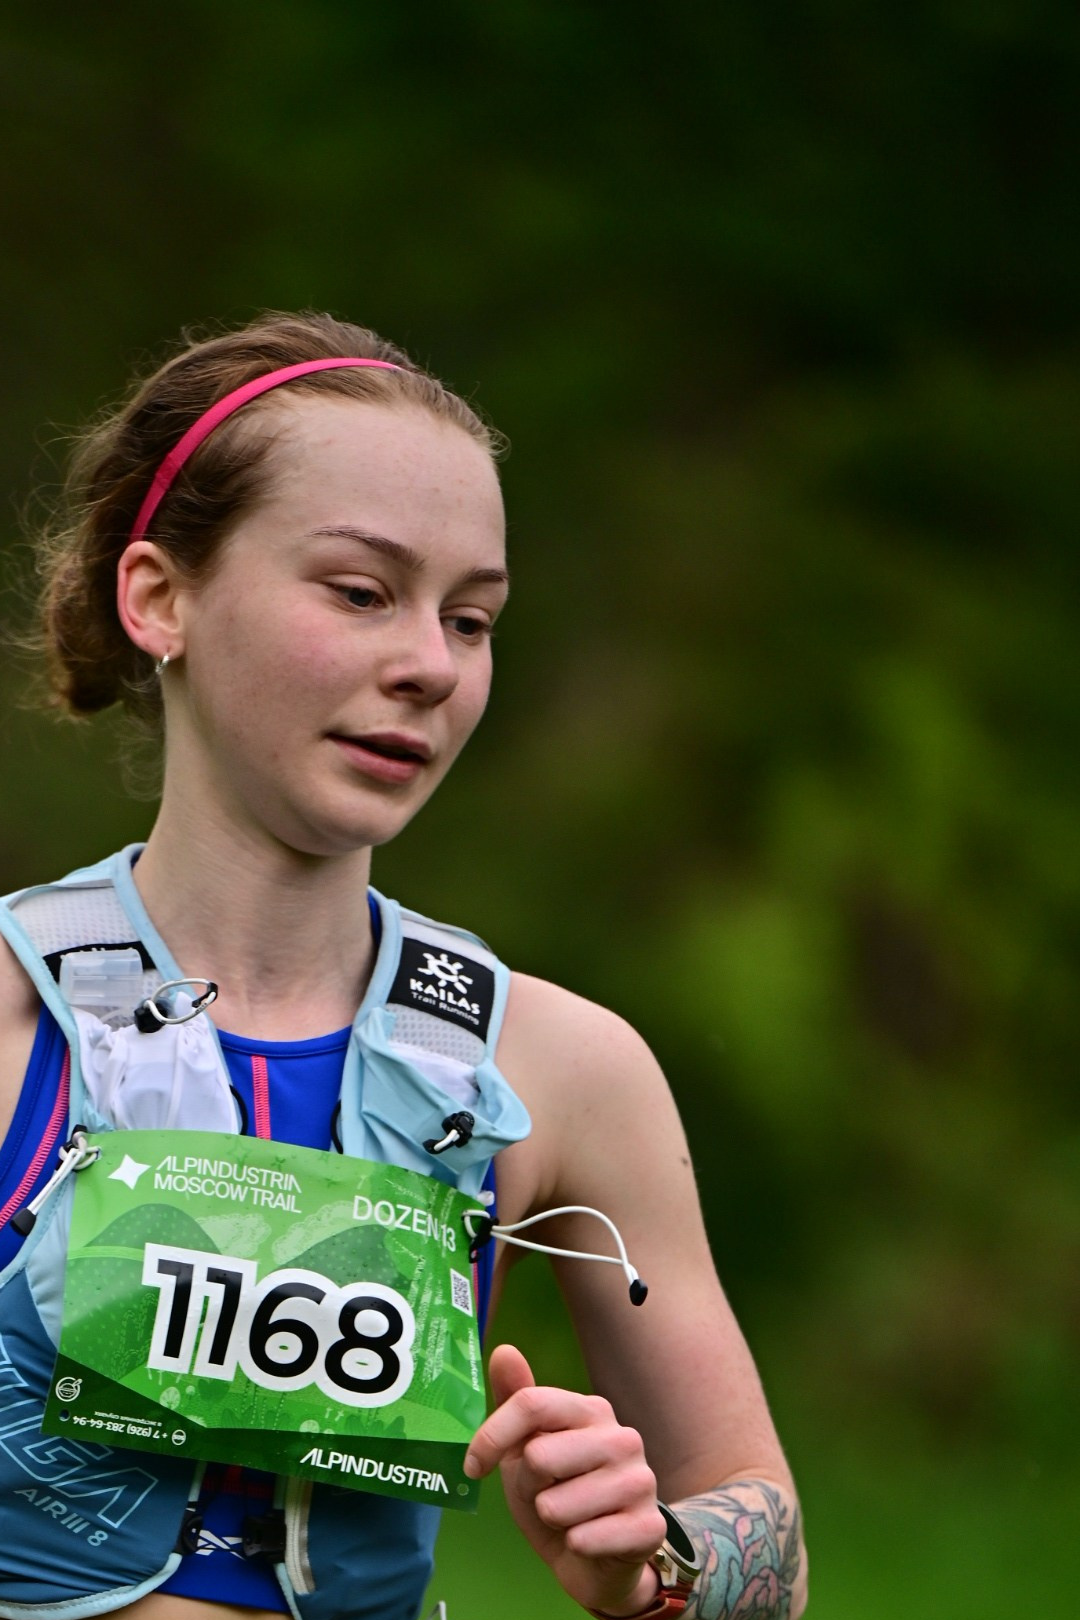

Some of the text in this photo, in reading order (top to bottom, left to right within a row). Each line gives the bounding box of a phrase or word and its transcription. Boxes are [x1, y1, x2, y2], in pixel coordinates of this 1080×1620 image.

[409, 978, 480, 1015] KAILAS
[411, 991, 480, 1026] Trail Running
[153, 1173, 302, 1214] MOSCOW TRAIL
[156, 1155, 302, 1194] ALPINDUSTRIA
[352, 1194, 457, 1253] DOZEN 13
[156, 1257, 404, 1395] 1168
[72, 1415, 126, 1433] 283-64-94
[126, 1423, 152, 1438] (926)
[299, 1447, 450, 1494] ALPINDUSTRIA
